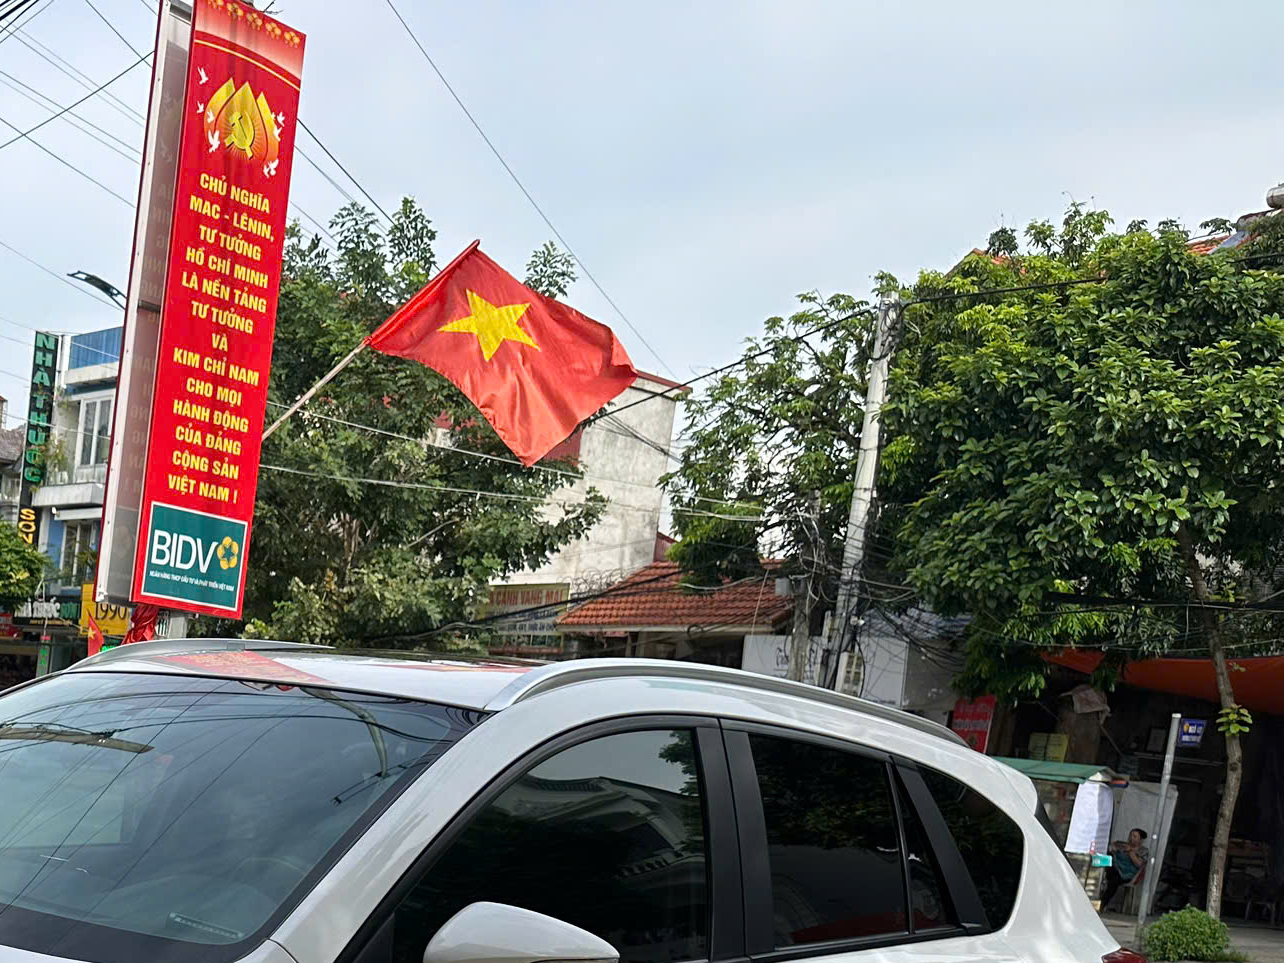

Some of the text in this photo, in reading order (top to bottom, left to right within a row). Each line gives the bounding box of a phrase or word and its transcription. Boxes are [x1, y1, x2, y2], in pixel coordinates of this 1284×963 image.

[200, 173, 270, 214] CHỦ NGHĨA
[199, 224, 261, 261] TƯ TƯỞNG
[233, 211, 274, 243] LÊNIN,
[185, 246, 268, 289] HỒ CHÍ MINH
[181, 271, 267, 314] LÀ NỀN TẢNG
[191, 300, 254, 335] TƯ TƯỞNG
[33, 332, 56, 387] NHÀ
[212, 333, 228, 352] VÀ
[173, 347, 260, 387] KIM CHỈ NAM
[186, 377, 242, 408] CHO MỌI
[173, 399, 249, 433] HÀNH ĐỘNG
[175, 422, 242, 456] CỦA ĐẢNG
[172, 449, 239, 480] CỘNG SẢN
[168, 474, 196, 495] VIỆT
[199, 481, 230, 502] NAM
[151, 528, 219, 574] BIDV
